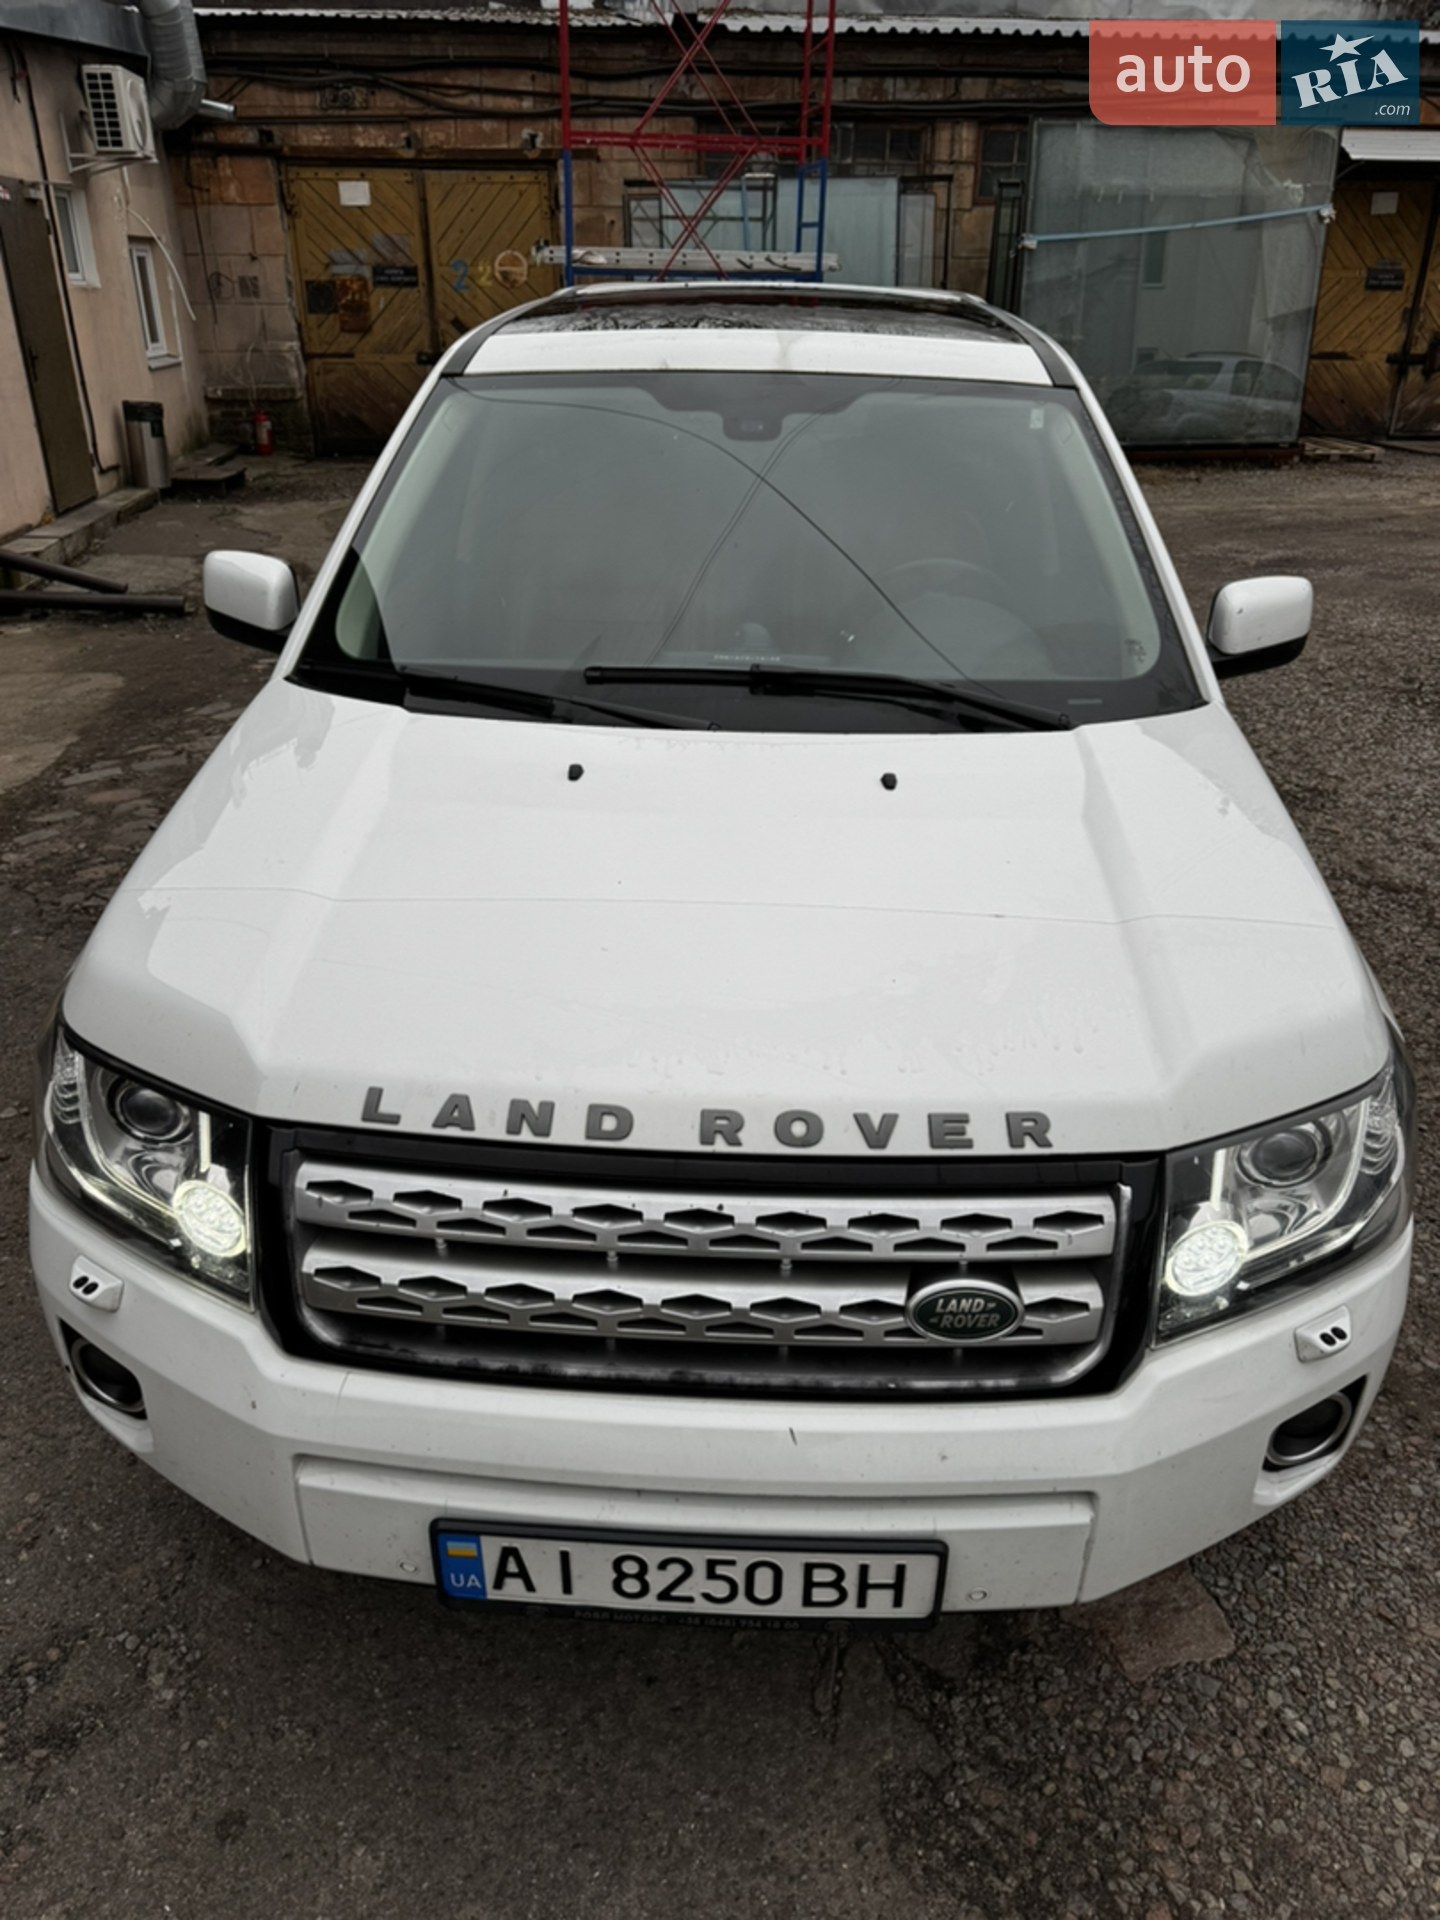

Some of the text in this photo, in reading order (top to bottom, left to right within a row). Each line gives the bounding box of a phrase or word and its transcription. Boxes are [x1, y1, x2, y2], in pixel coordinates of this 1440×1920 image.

[451, 259, 470, 292] 2
[361, 1086, 1053, 1149] LAND ROVER
[935, 1297, 985, 1313] LAND
[940, 1313, 1001, 1328] ROVER
[450, 1573, 482, 1589] UA
[492, 1546, 906, 1608] AI 8250 BH
